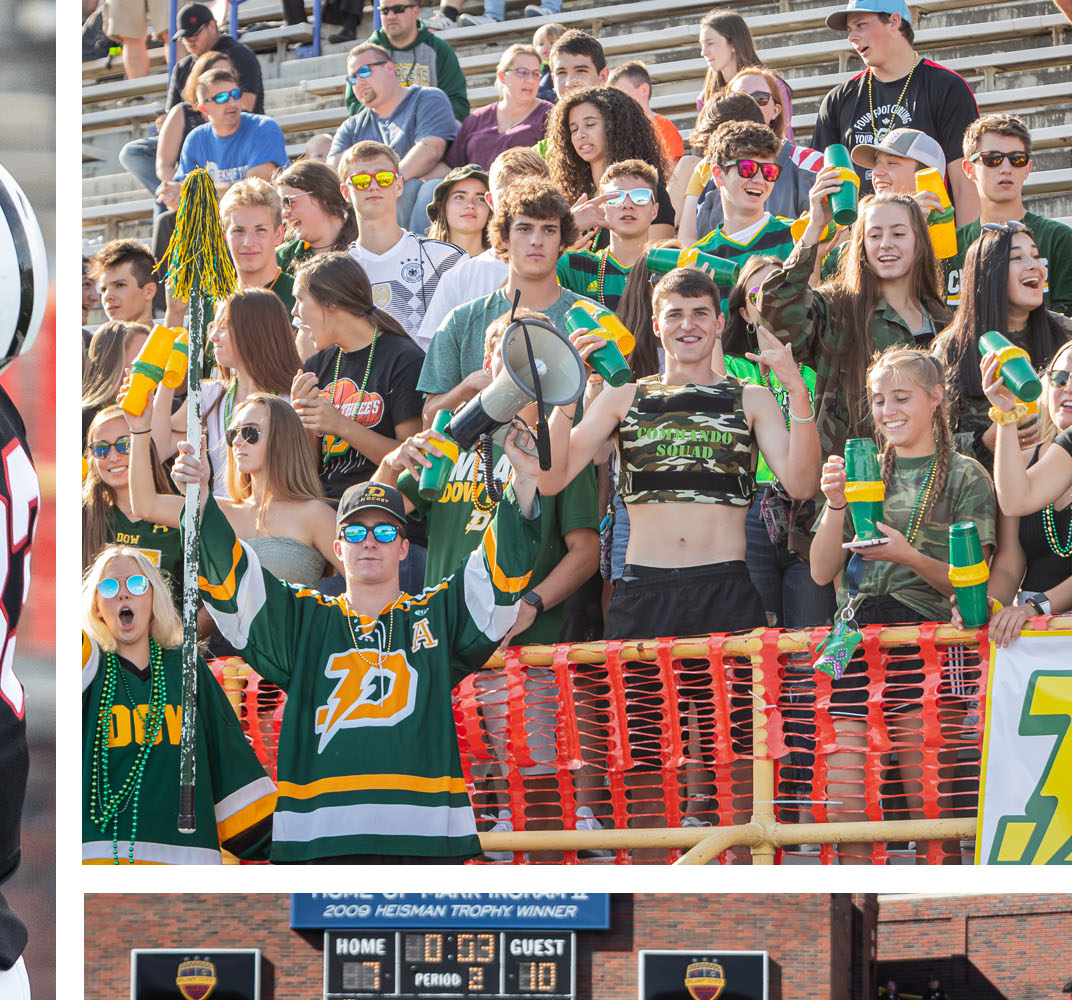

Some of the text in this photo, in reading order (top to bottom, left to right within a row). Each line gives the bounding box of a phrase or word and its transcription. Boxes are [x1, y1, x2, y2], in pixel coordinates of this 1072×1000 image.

[855, 134, 873, 145] YOUR
[637, 427, 733, 445] COMMANDO
[656, 444, 713, 459] SQUAD
[493, 453, 512, 483] A
[438, 481, 485, 503] DOW
[117, 532, 140, 545] DOW
[411, 618, 438, 653] A
[102, 704, 182, 748] DOW
[323, 904, 578, 918] 2009 HEISMAN TROPHY WINNER
[336, 938, 387, 955] HOME
[510, 939, 565, 956] GUEST
[362, 961, 381, 990] 7
[414, 967, 483, 990] PERIOD 2
[530, 962, 556, 991] 10
